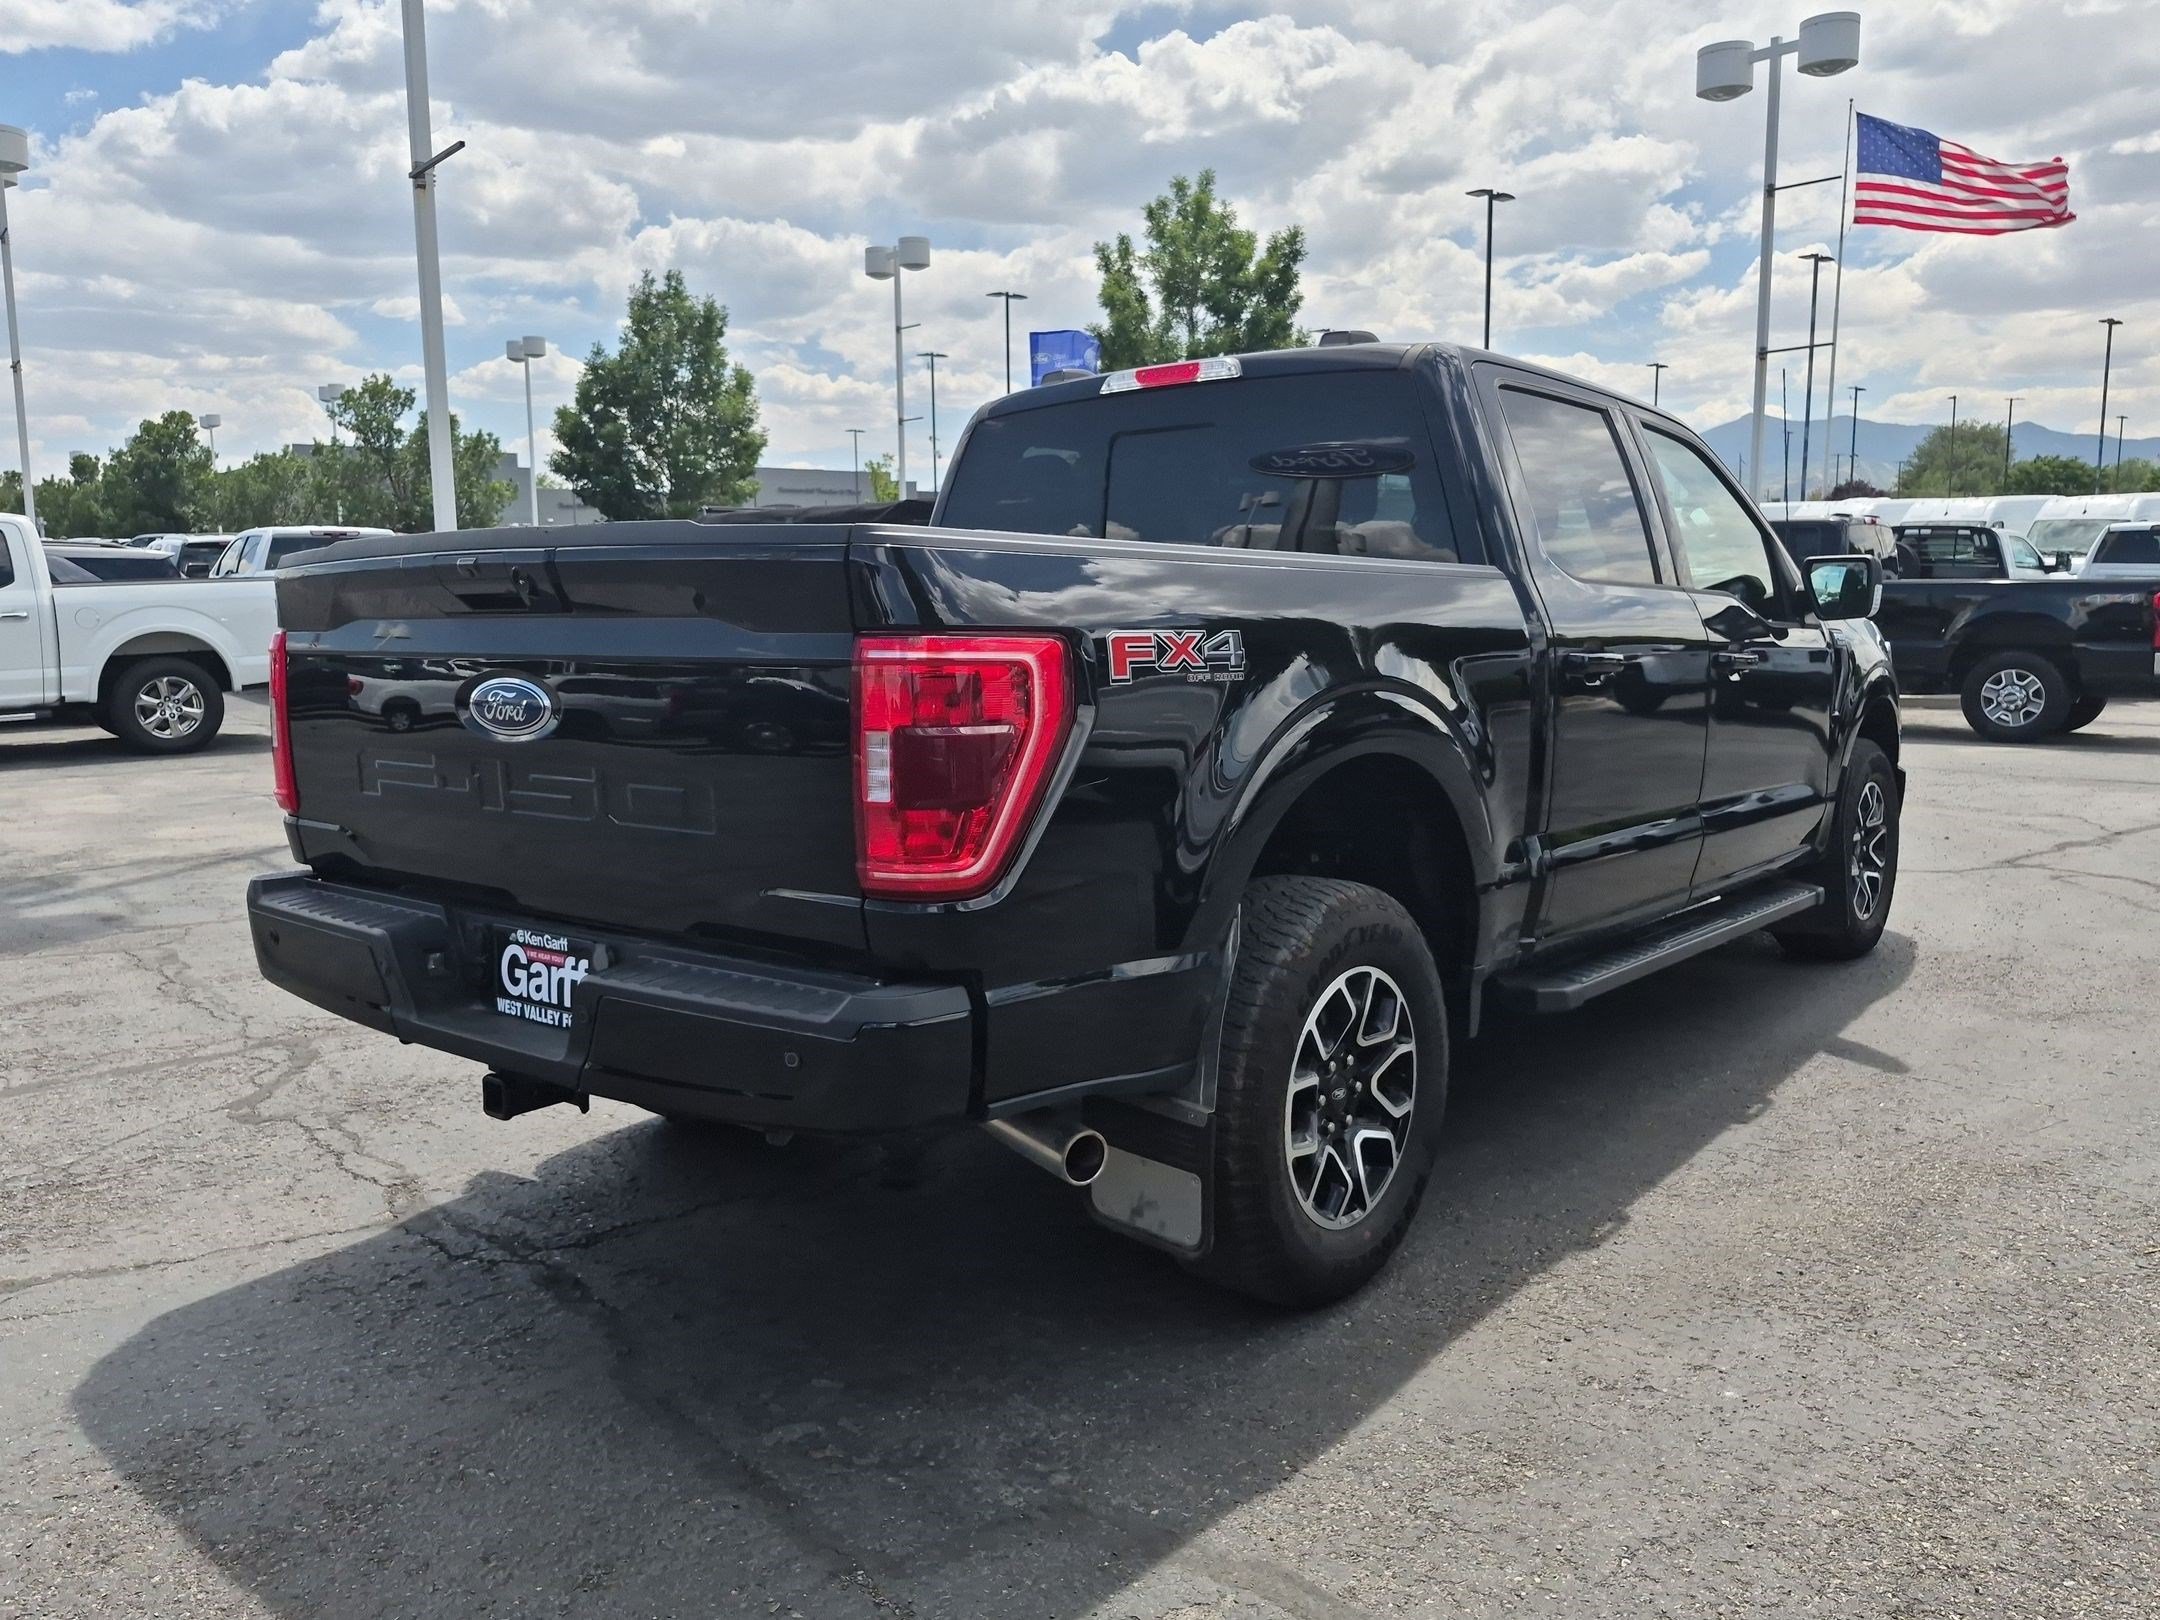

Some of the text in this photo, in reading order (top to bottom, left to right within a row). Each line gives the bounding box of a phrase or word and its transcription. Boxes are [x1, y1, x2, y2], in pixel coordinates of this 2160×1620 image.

[1106, 630, 1245, 685] FX4
[1187, 672, 1245, 682] OFF ROAD
[484, 690, 527, 721] Ford
[356, 750, 716, 835] F-150
[524, 930, 568, 951] Ken Garff
[497, 997, 522, 1016] WEST
[523, 1004, 560, 1026] VALLEY
